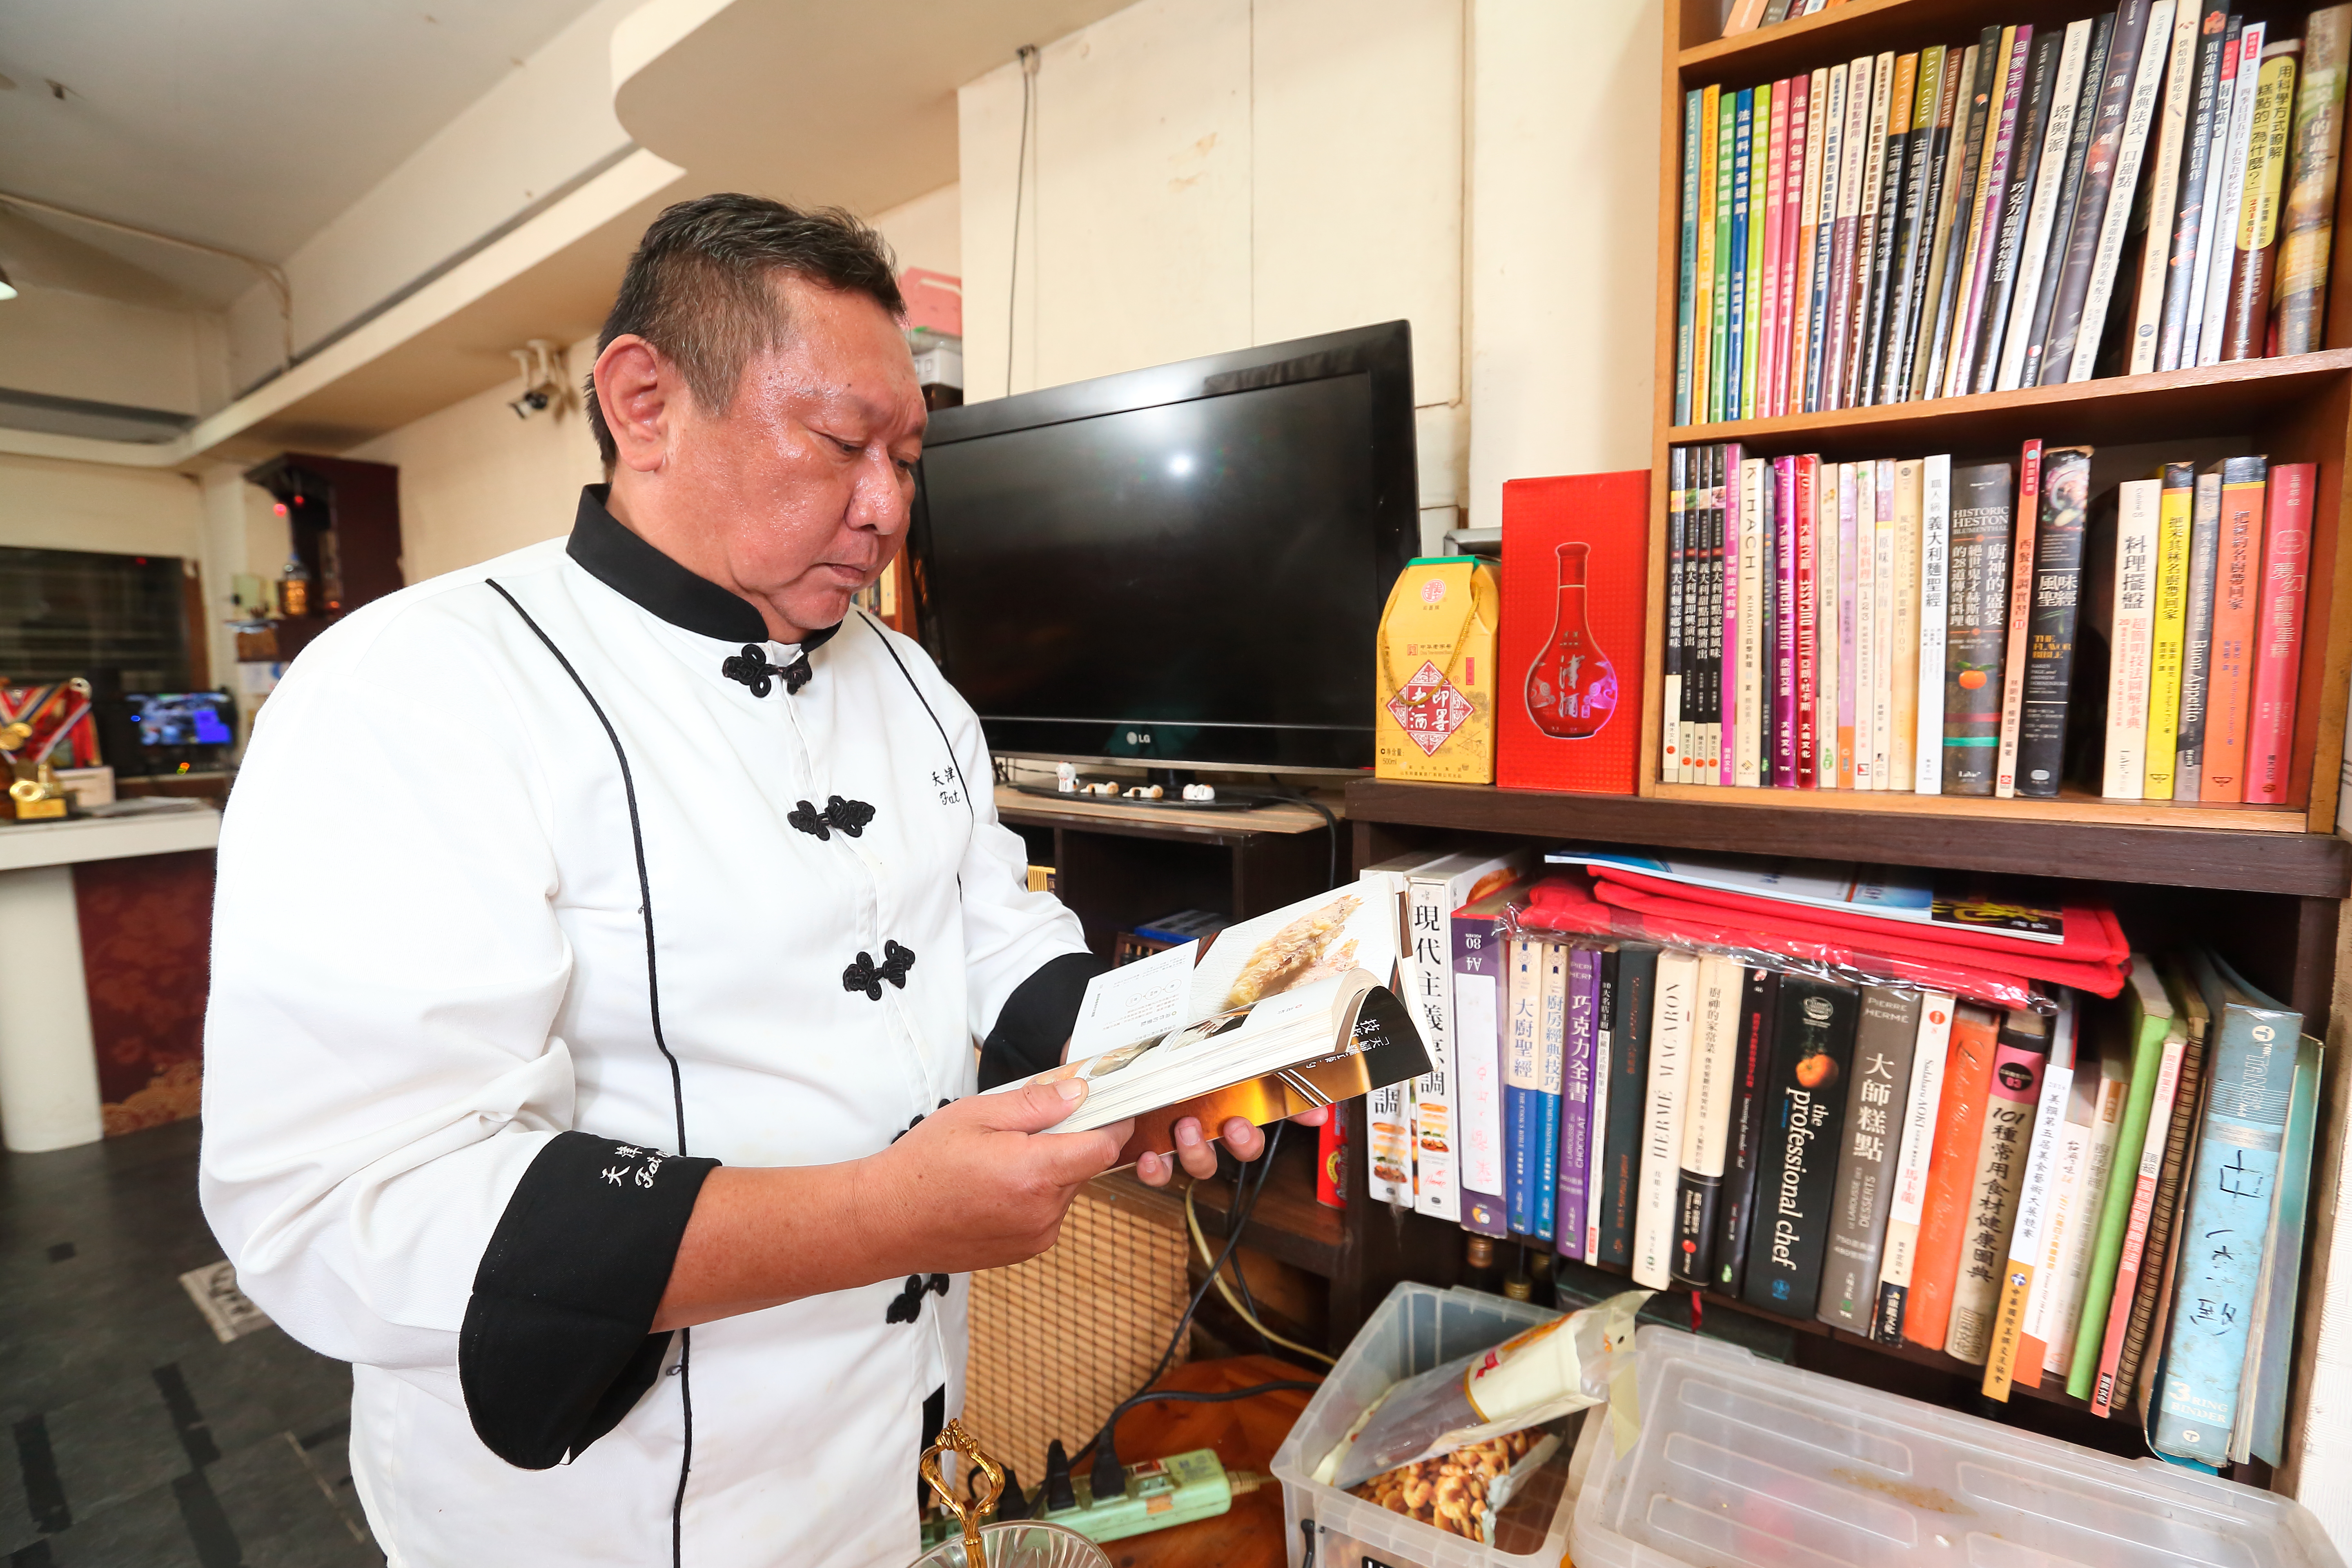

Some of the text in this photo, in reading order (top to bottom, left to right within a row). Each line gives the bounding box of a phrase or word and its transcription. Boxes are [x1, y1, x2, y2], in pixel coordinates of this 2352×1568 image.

[1895, 58, 1909, 129] EASY COOK
[1919, 51, 1938, 123] EASY COOK
[2005, 40, 2027, 100] 自家手作
[2046, 103, 2072, 154] 塔與派
[2115, 84, 2153, 189] 經典法式一口甜點
[2268, 65, 2293, 159] 用科學方式瞭解
[1744, 466, 1757, 581] KIHACHI
[1953, 507, 2009, 519] HISTORIC
[1953, 515, 2009, 529] HESTON
[1926, 516, 1943, 608] 義大利麵聖經
[1949, 545, 1967, 627] 的28道傳奇料理
[1964, 544, 1982, 627] 絕世鬼才赫斯頓
[1984, 543, 2007, 626] 廚神的盛宴
[2040, 574, 2078, 592] 風味
[2123, 535, 2147, 610] 料理擺盤
[2228, 510, 2250, 610] 把紐約名廚帶回家
[1696, 562, 1710, 660] 義大利甜點即興演出
[1709, 560, 1723, 658] 義大利甜點家鄉風味
[1745, 595, 1755, 635] KIHACHI
[1799, 579, 1814, 626] DUCASSE
[2037, 589, 2077, 608] 聖經
[2191, 640, 2208, 670] Buon
[2184, 673, 2206, 723] Appetito
[1138, 734, 1150, 743] LG
[1465, 938, 1482, 950] 80
[1466, 956, 1483, 972] A4
[1659, 982, 1682, 1078] MACARON
[1867, 996, 1908, 1012] PIERRE
[1513, 998, 1535, 1079] 大廚聖經
[1544, 995, 1564, 1093] 廚房經典技巧
[1568, 994, 1592, 1104] 巧克力全書
[1852, 1052, 1895, 1163] 大師糕點
[1915, 1098, 1929, 1129] AOKI
[1575, 1116, 1587, 1168] CHOCOLAT
[1771, 1087, 1830, 1271] the professional chef
[1858, 1175, 1876, 1228] DESSERTS
[2169, 1381, 2228, 1413] 3 RING
[2171, 1401, 2227, 1424] BINDER
